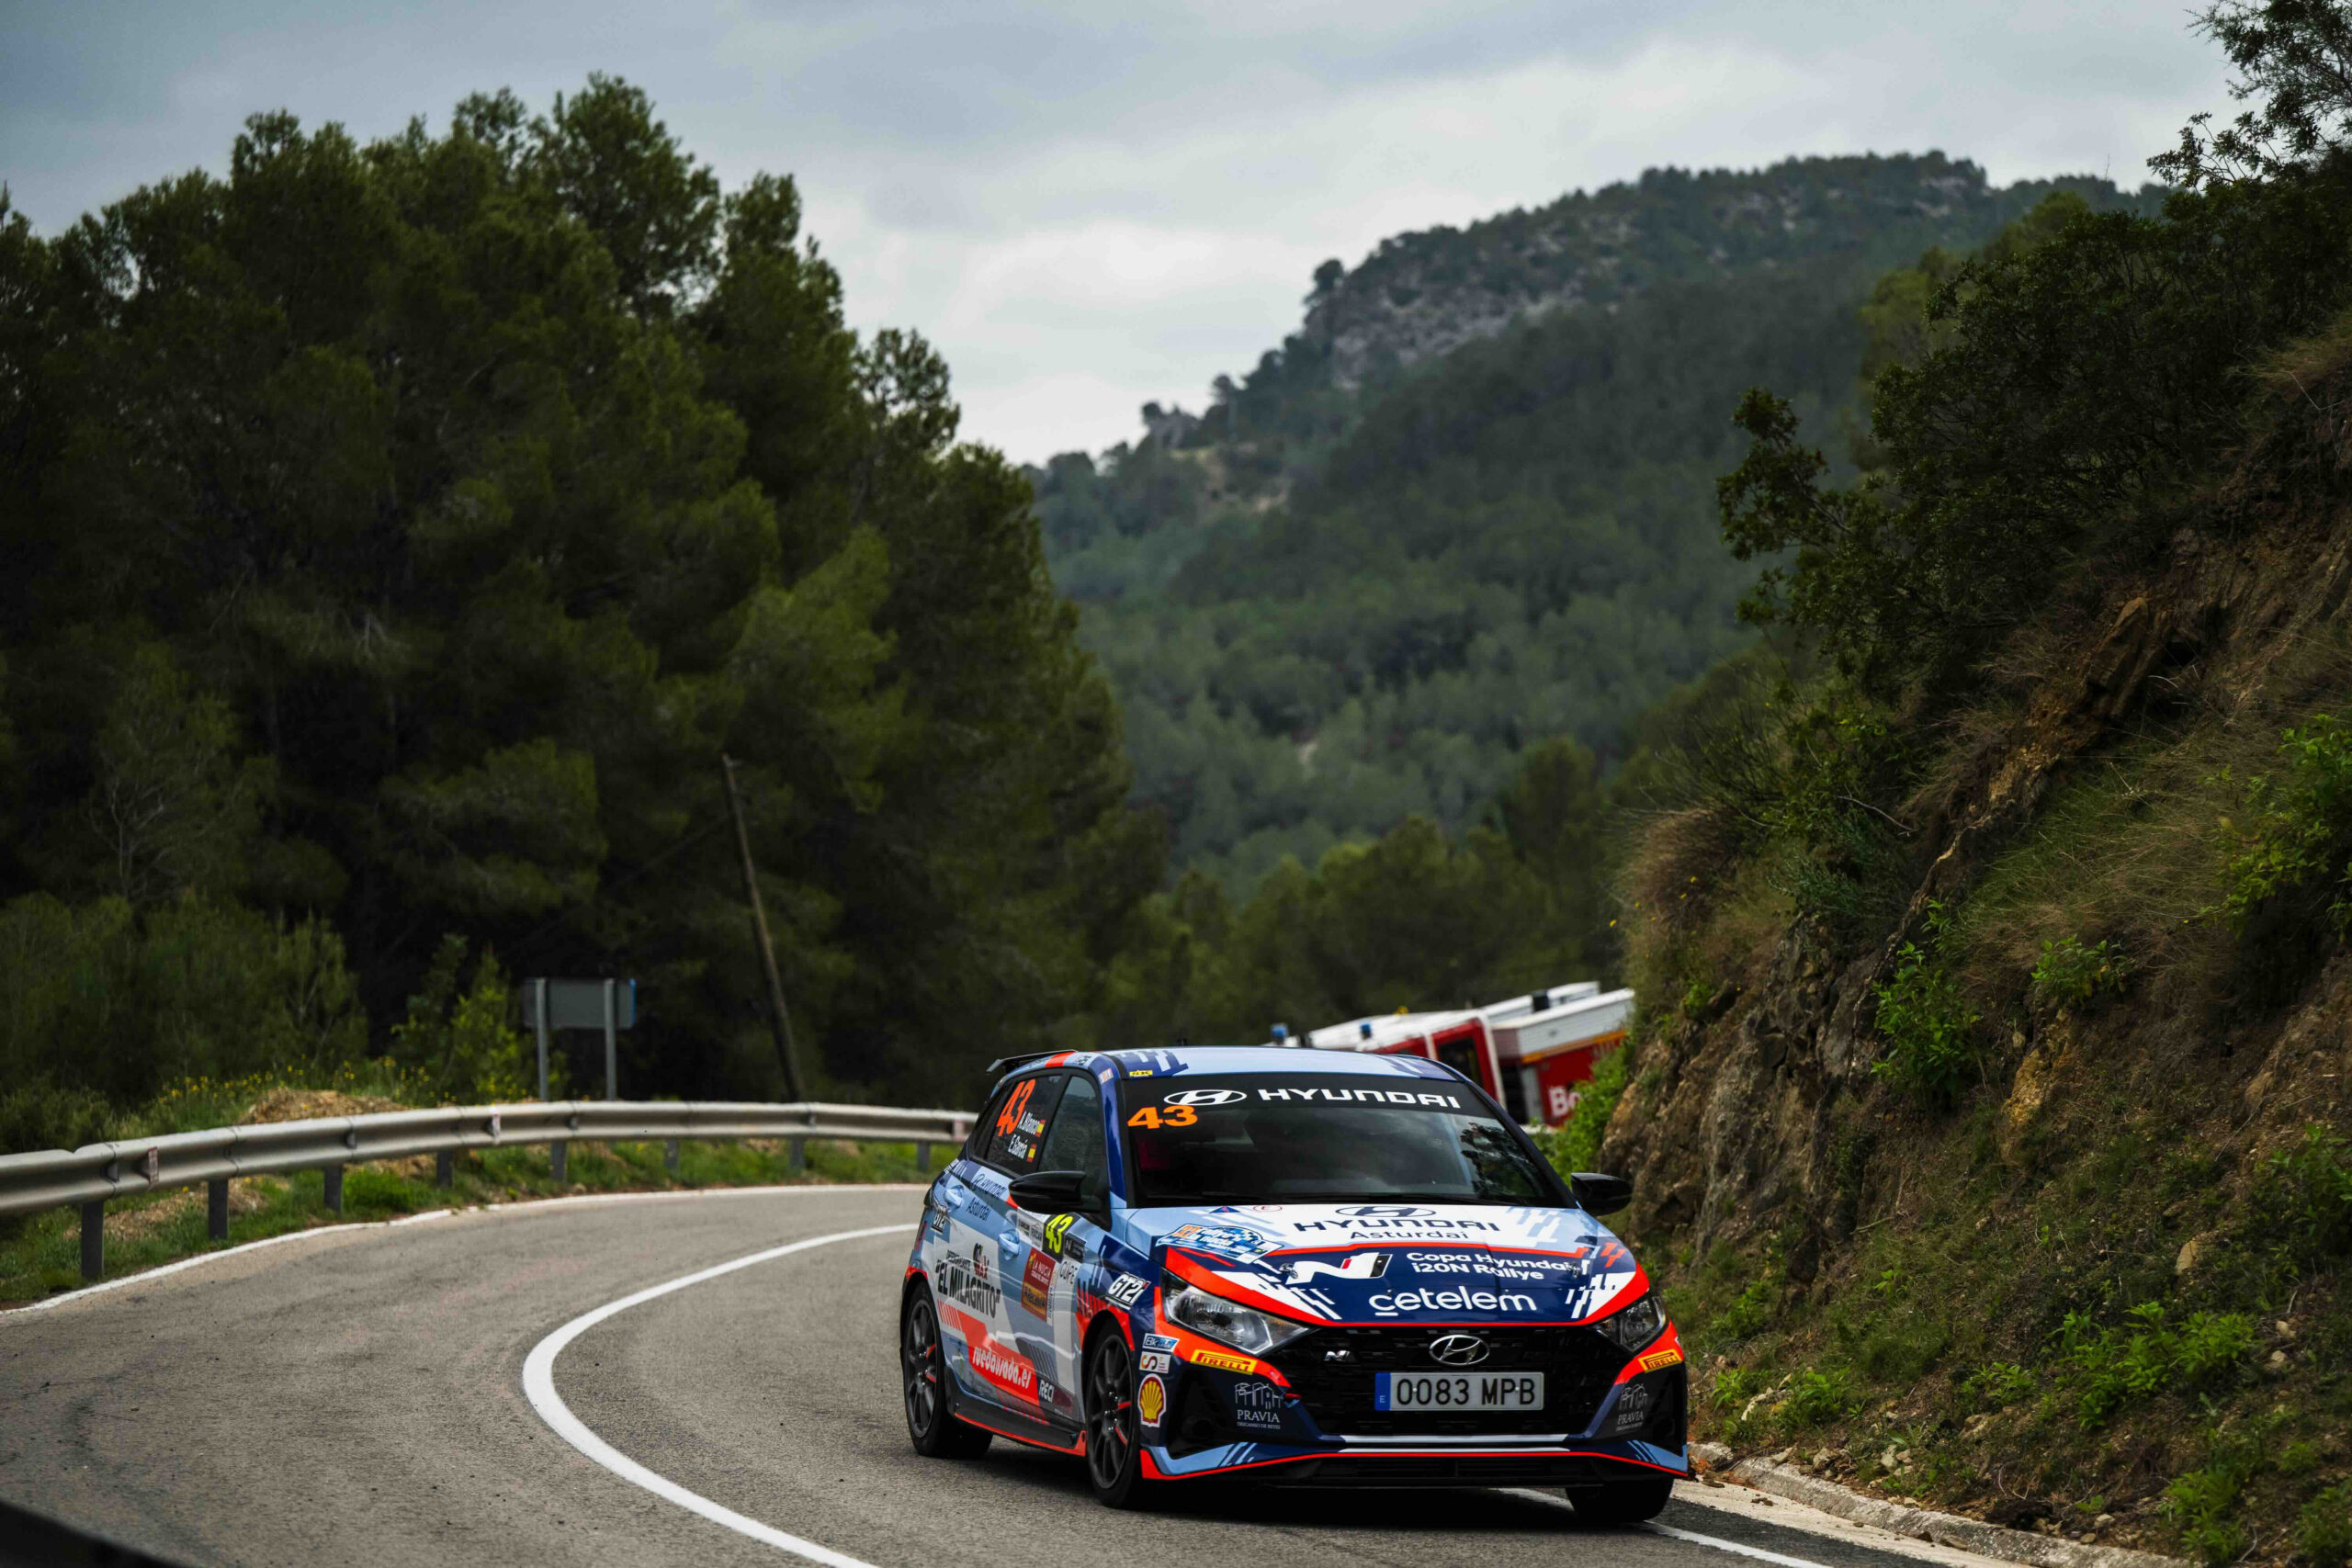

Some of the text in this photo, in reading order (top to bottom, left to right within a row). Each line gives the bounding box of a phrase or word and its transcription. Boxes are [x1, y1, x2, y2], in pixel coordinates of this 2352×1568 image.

[996, 1078, 1035, 1137] 43
[1258, 1089, 1461, 1108] HYUNDAI
[1127, 1105, 1198, 1129] 43
[1046, 1213, 1073, 1253] 43
[1294, 1220, 1500, 1232] HYUNDAI
[1351, 1231, 1469, 1239] Asturdai
[1407, 1252, 1570, 1271] Copa Hyundai
[1411, 1263, 1544, 1280] i20N Rallye
[1369, 1286, 1537, 1312] cetelem
[1196, 1352, 1251, 1371] PIRELLI
[1643, 1351, 1679, 1370] PIRELLI
[1396, 1379, 1535, 1405] 0083 MPB
[1237, 1409, 1280, 1423] PRAVIA
[1618, 1411, 1645, 1424] PRAVIA
